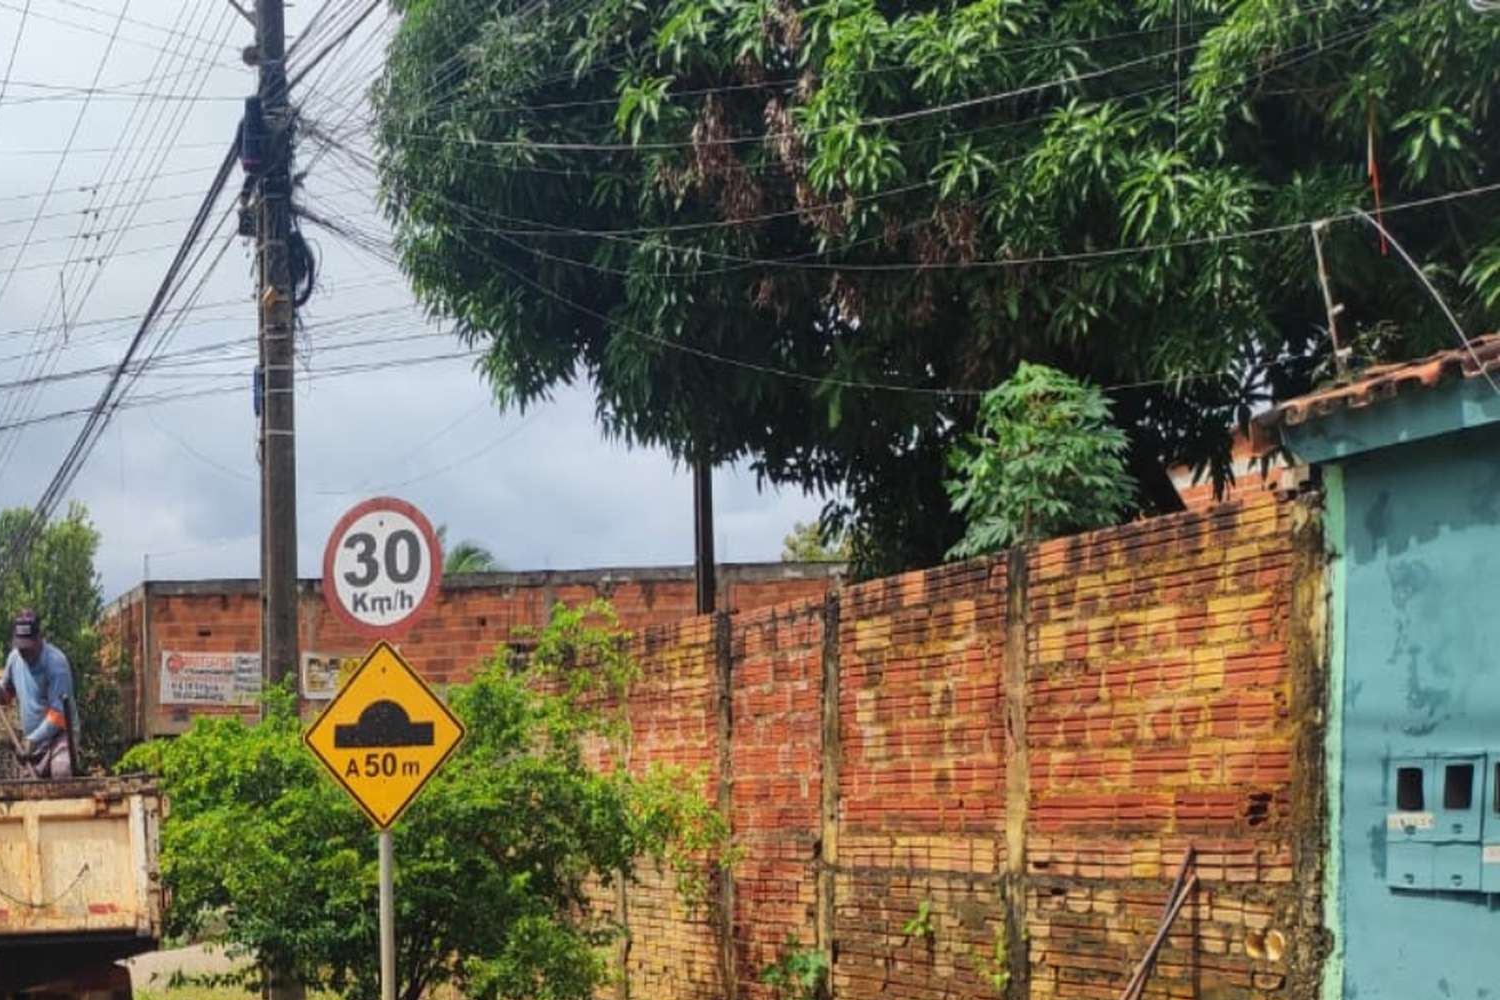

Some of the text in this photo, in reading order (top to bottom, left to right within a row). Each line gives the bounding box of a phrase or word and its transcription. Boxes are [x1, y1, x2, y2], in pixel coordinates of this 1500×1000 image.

[343, 529, 421, 588] 30
[352, 588, 413, 616] Km/h
[345, 752, 420, 777] A 50 m
